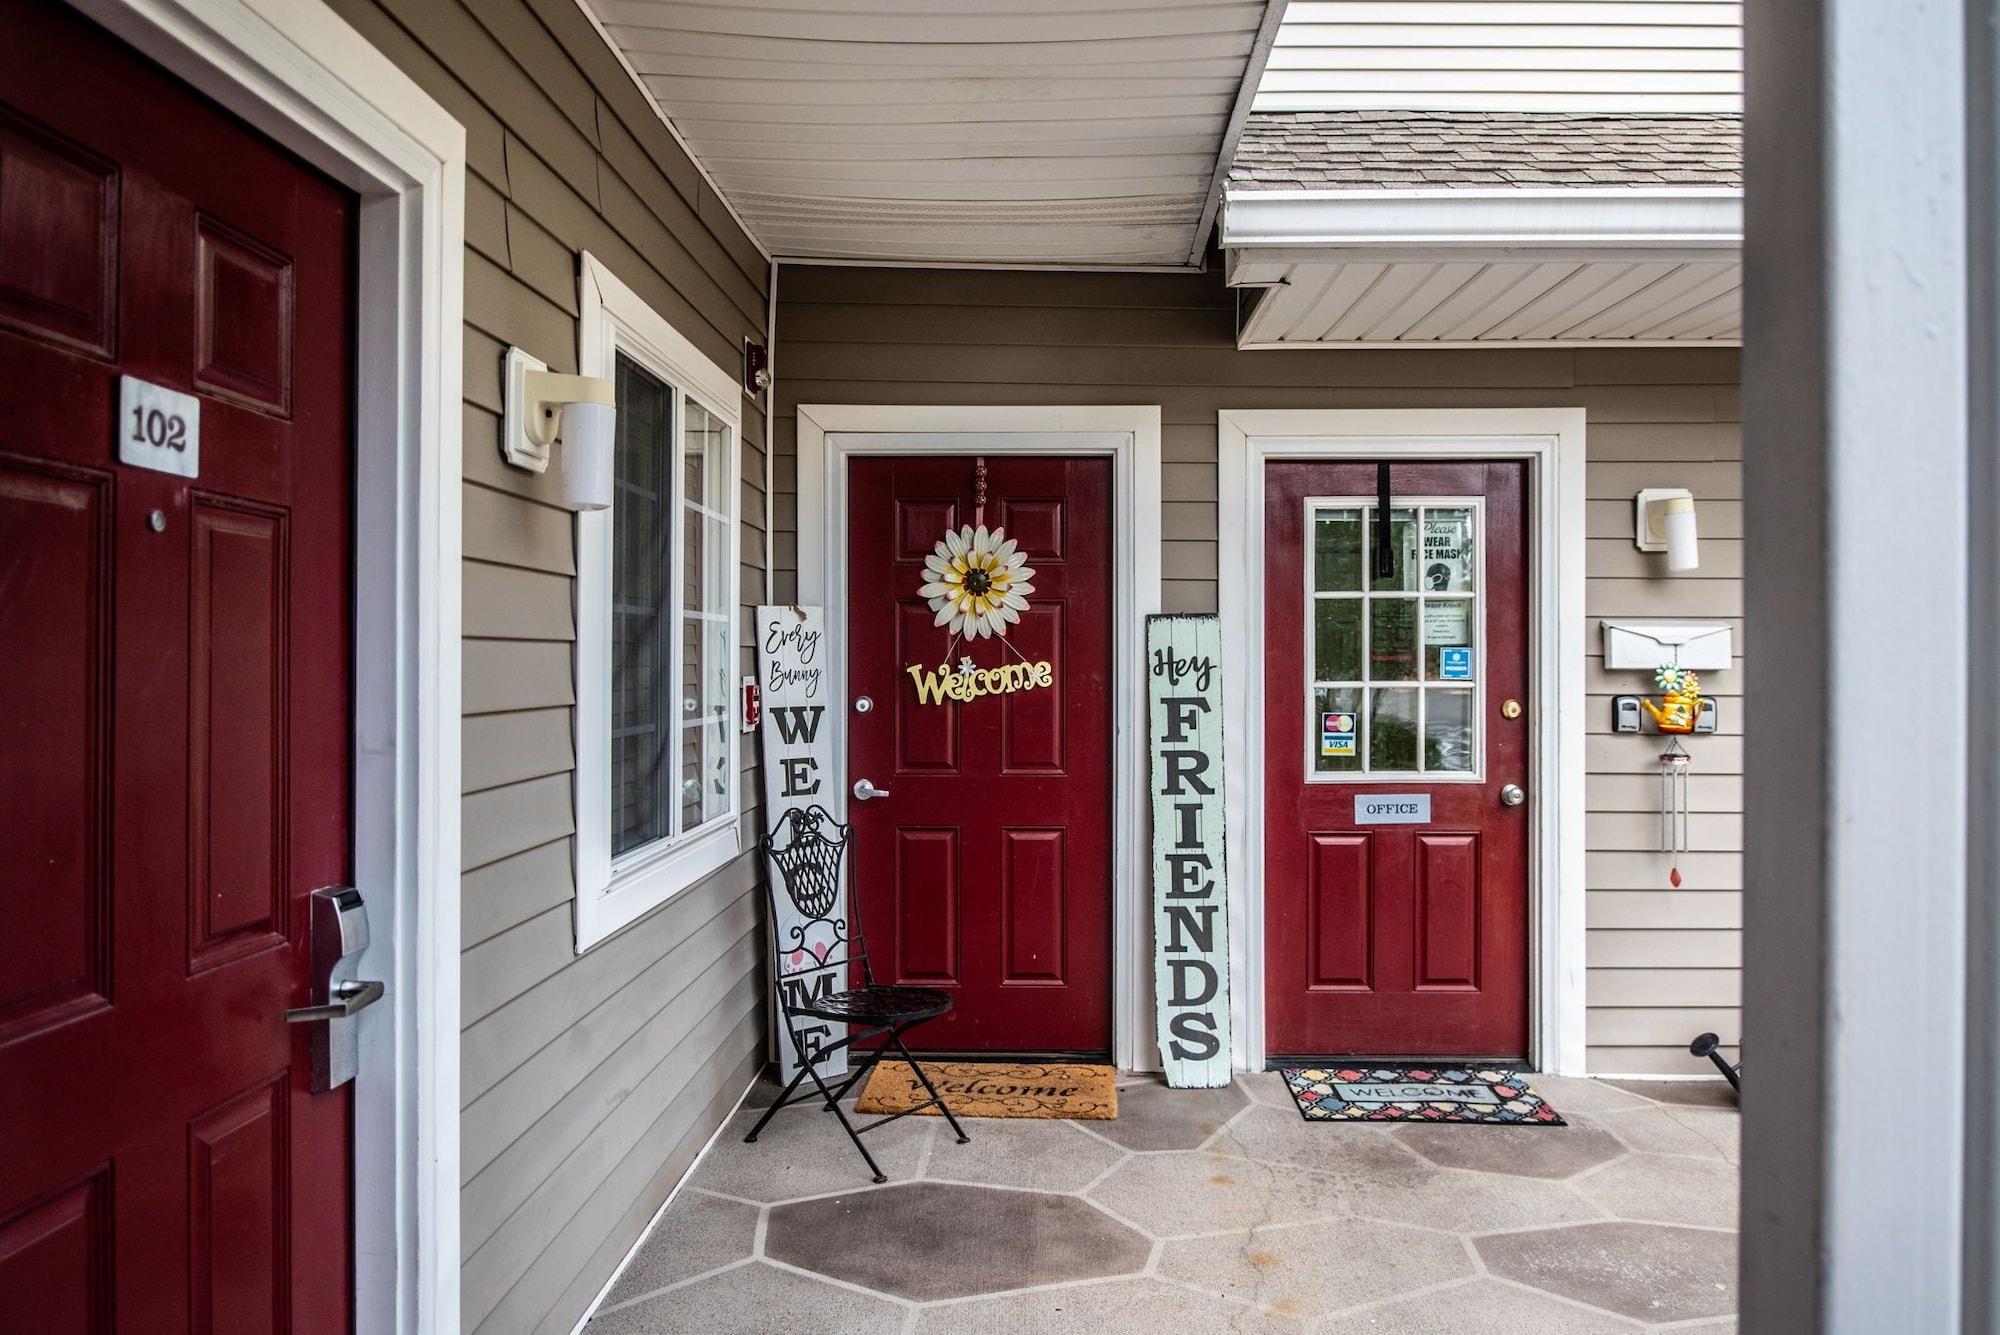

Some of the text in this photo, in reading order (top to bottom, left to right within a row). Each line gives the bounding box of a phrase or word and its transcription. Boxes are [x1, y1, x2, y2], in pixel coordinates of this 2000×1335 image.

[132, 404, 186, 453] 102
[1424, 522, 1457, 534] Please
[1424, 536, 1451, 547] WEAR
[1411, 549, 1434, 560] FCE
[765, 621, 822, 664] Every
[769, 660, 823, 698] Bunny
[906, 655, 1053, 706] Welcome
[1153, 646, 1218, 692] Hey
[1366, 803, 1418, 815] OFFICE
[1160, 696, 1220, 1062] FRIENDS
[904, 1078, 1083, 1097] Welcome
[1350, 1086, 1487, 1100] WELCOME
